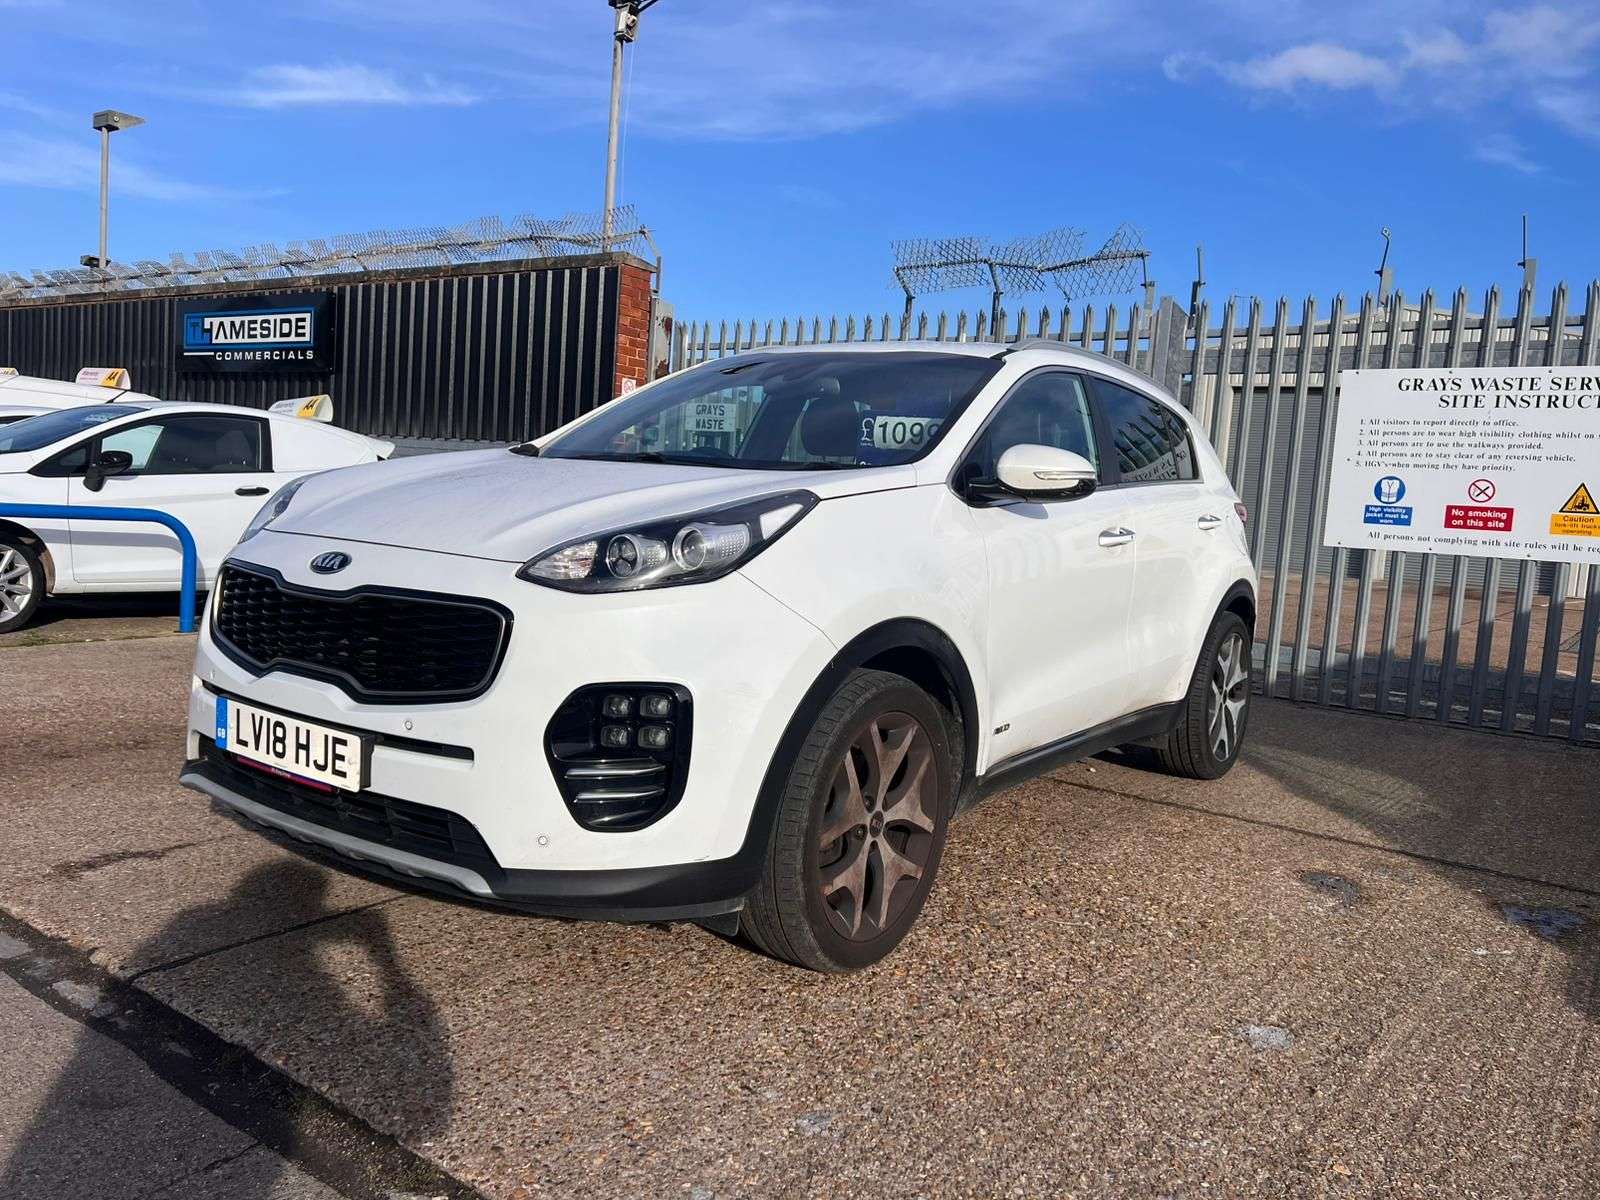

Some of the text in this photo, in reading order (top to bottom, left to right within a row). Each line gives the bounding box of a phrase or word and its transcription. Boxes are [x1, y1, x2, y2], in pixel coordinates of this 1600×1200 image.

[191, 317, 307, 340] THAMESIDE
[215, 350, 314, 361] COMMERCIALS
[1398, 377, 1463, 392] GRAYS
[1470, 377, 1542, 392] WASTE
[1438, 394, 1486, 409] SITE
[695, 404, 725, 416] GRAYS
[695, 418, 725, 430] WASTE
[1449, 419, 1479, 427] directly
[1493, 419, 1519, 427] office.
[1459, 430, 1477, 438] high
[1480, 430, 1514, 438] visibility
[1518, 431, 1552, 439] clothing
[1555, 431, 1581, 439] whilst
[1467, 441, 1504, 450] walkways
[1507, 442, 1544, 450] provided.
[1505, 454, 1543, 462] reversing
[1545, 454, 1576, 462] vehicle.
[1443, 462, 1458, 470] they
[1462, 462, 1480, 470] have
[1481, 463, 1516, 472] priority.
[1451, 508, 1507, 520] No smoking
[1562, 515, 1595, 523] Caution
[1466, 518, 1483, 527] this
[1487, 519, 1505, 528] site
[1368, 531, 1380, 539] All
[1383, 533, 1414, 541] persons
[1417, 534, 1431, 542] not
[1434, 536, 1478, 546] complying
[1481, 539, 1501, 547] with
[1504, 539, 1520, 548] site
[1524, 541, 1547, 550] rules
[1551, 543, 1569, 551] will
[1573, 543, 1583, 551] be
[312, 554, 345, 570] KIA
[236, 708, 348, 779] LV18 HJE
